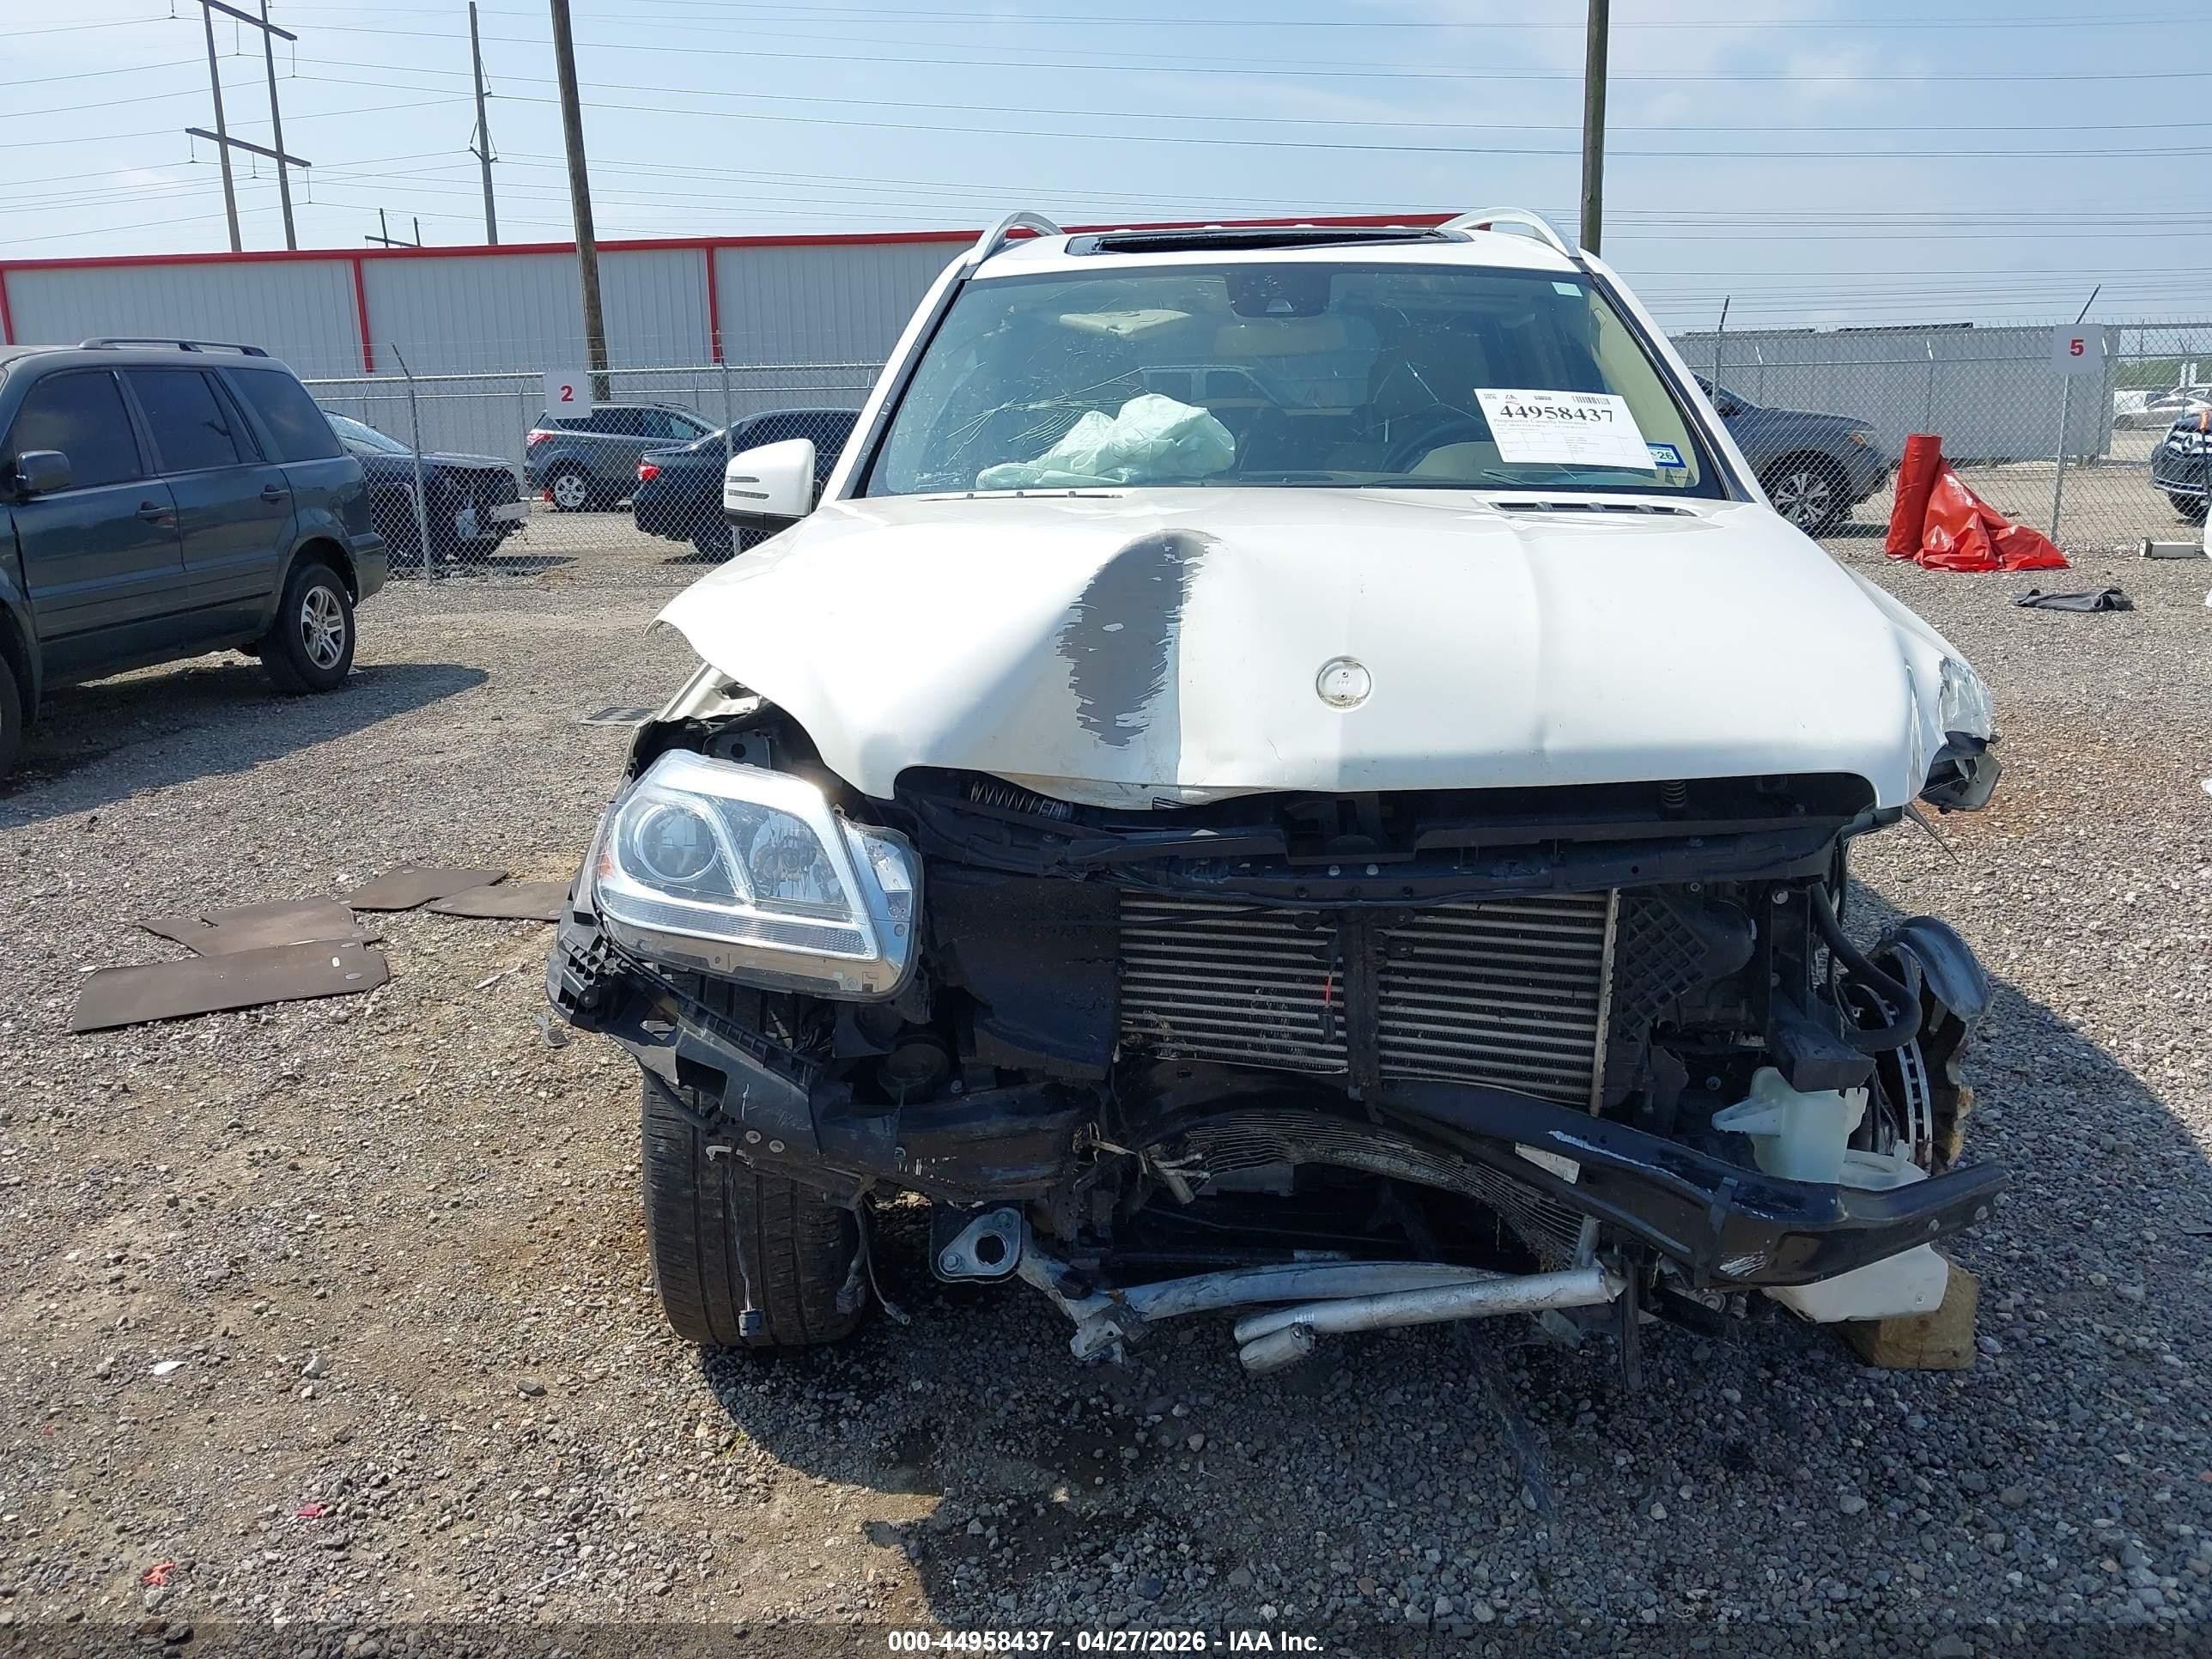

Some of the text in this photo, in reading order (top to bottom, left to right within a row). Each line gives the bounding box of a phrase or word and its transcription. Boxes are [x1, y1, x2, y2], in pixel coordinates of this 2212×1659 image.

[2070, 339, 2084, 356] 5
[561, 386, 574, 402] 2
[1500, 405, 1613, 422] 44958437
[1657, 451, 1674, 460] 26
